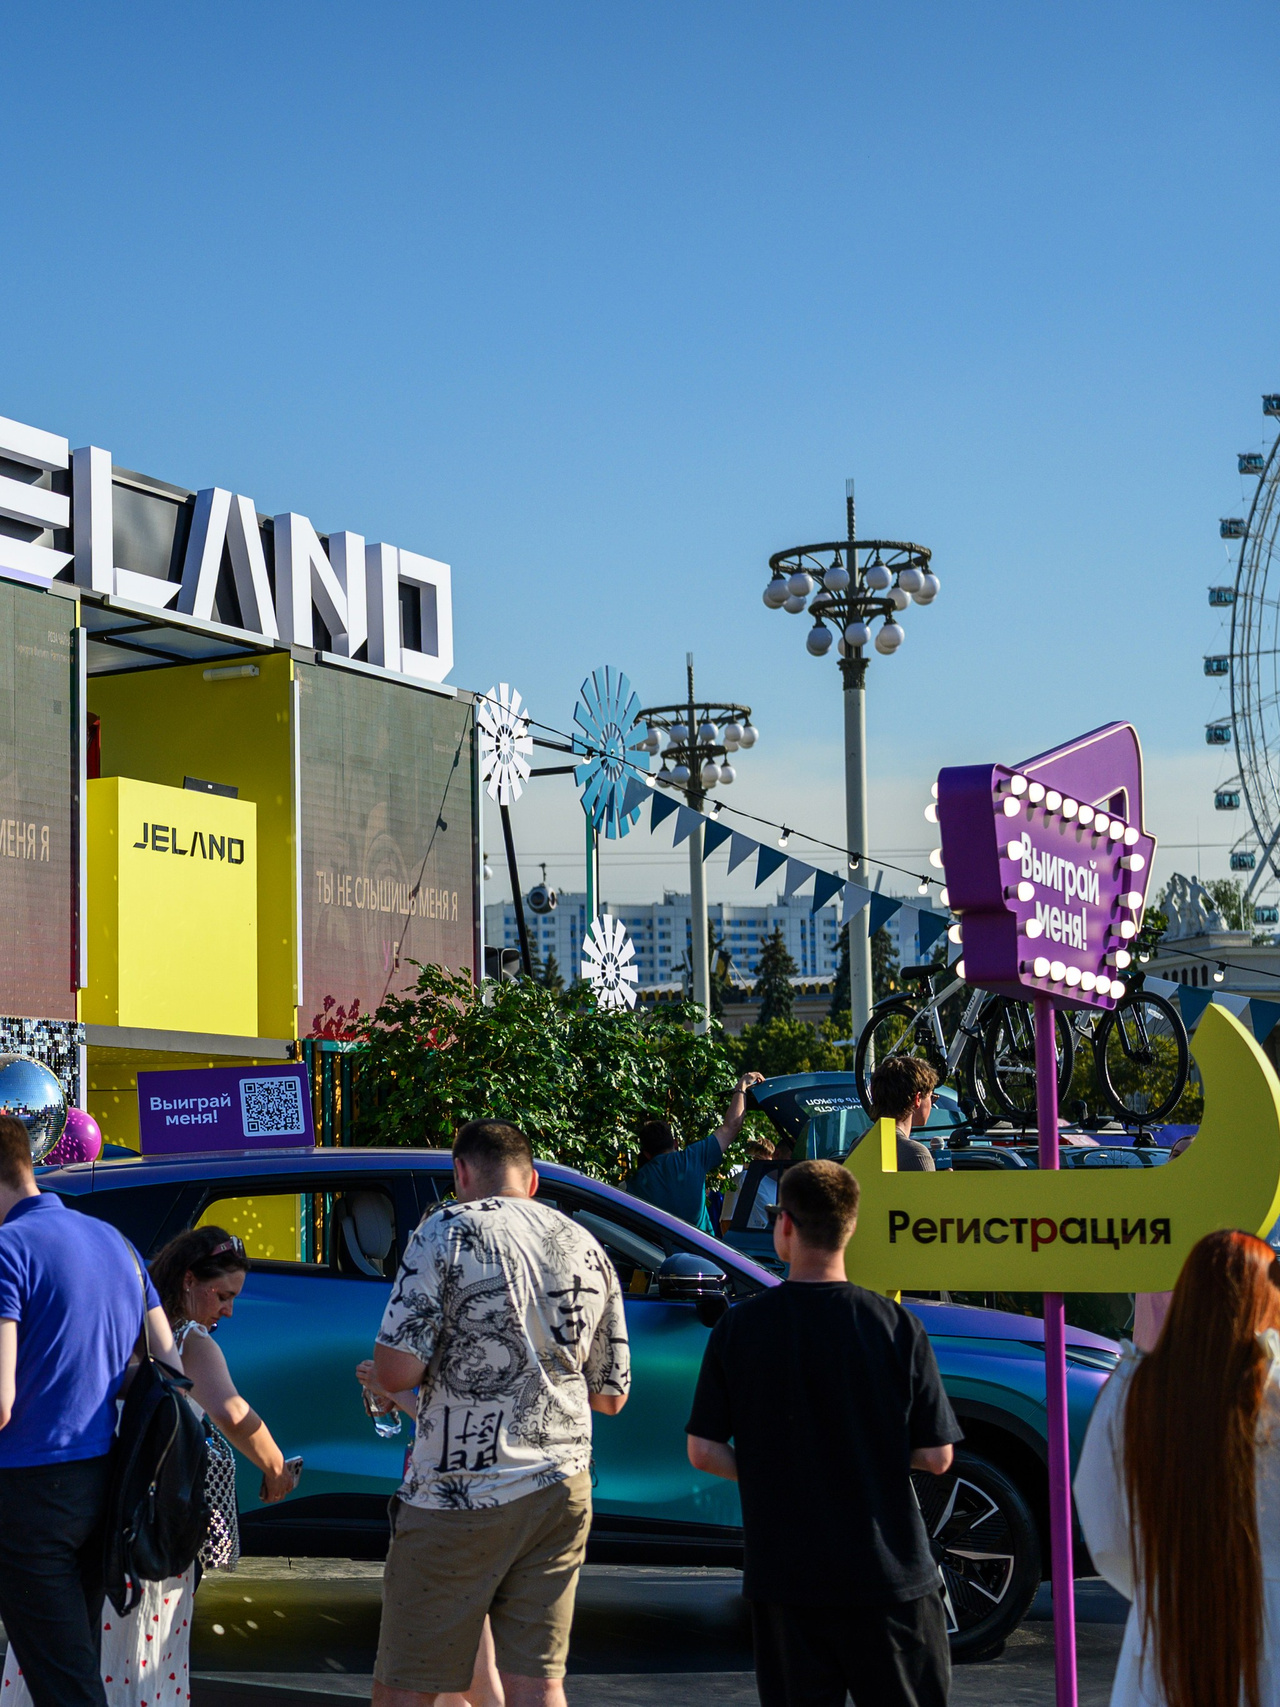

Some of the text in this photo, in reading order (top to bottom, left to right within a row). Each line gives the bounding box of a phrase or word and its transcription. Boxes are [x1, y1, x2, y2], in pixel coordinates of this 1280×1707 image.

[40, 825, 50, 862] Я
[133, 822, 244, 865] JELAND
[1021, 832, 1100, 906] Выиграй
[316, 871, 458, 922] ТЫ НЕ СЛЫШИШЬ МЕНЯ Я
[1035, 901, 1087, 951] меня!
[149, 1093, 231, 1112] Выиграй
[165, 1110, 218, 1126] меня!
[888, 1210, 1172, 1252] Регистрация
